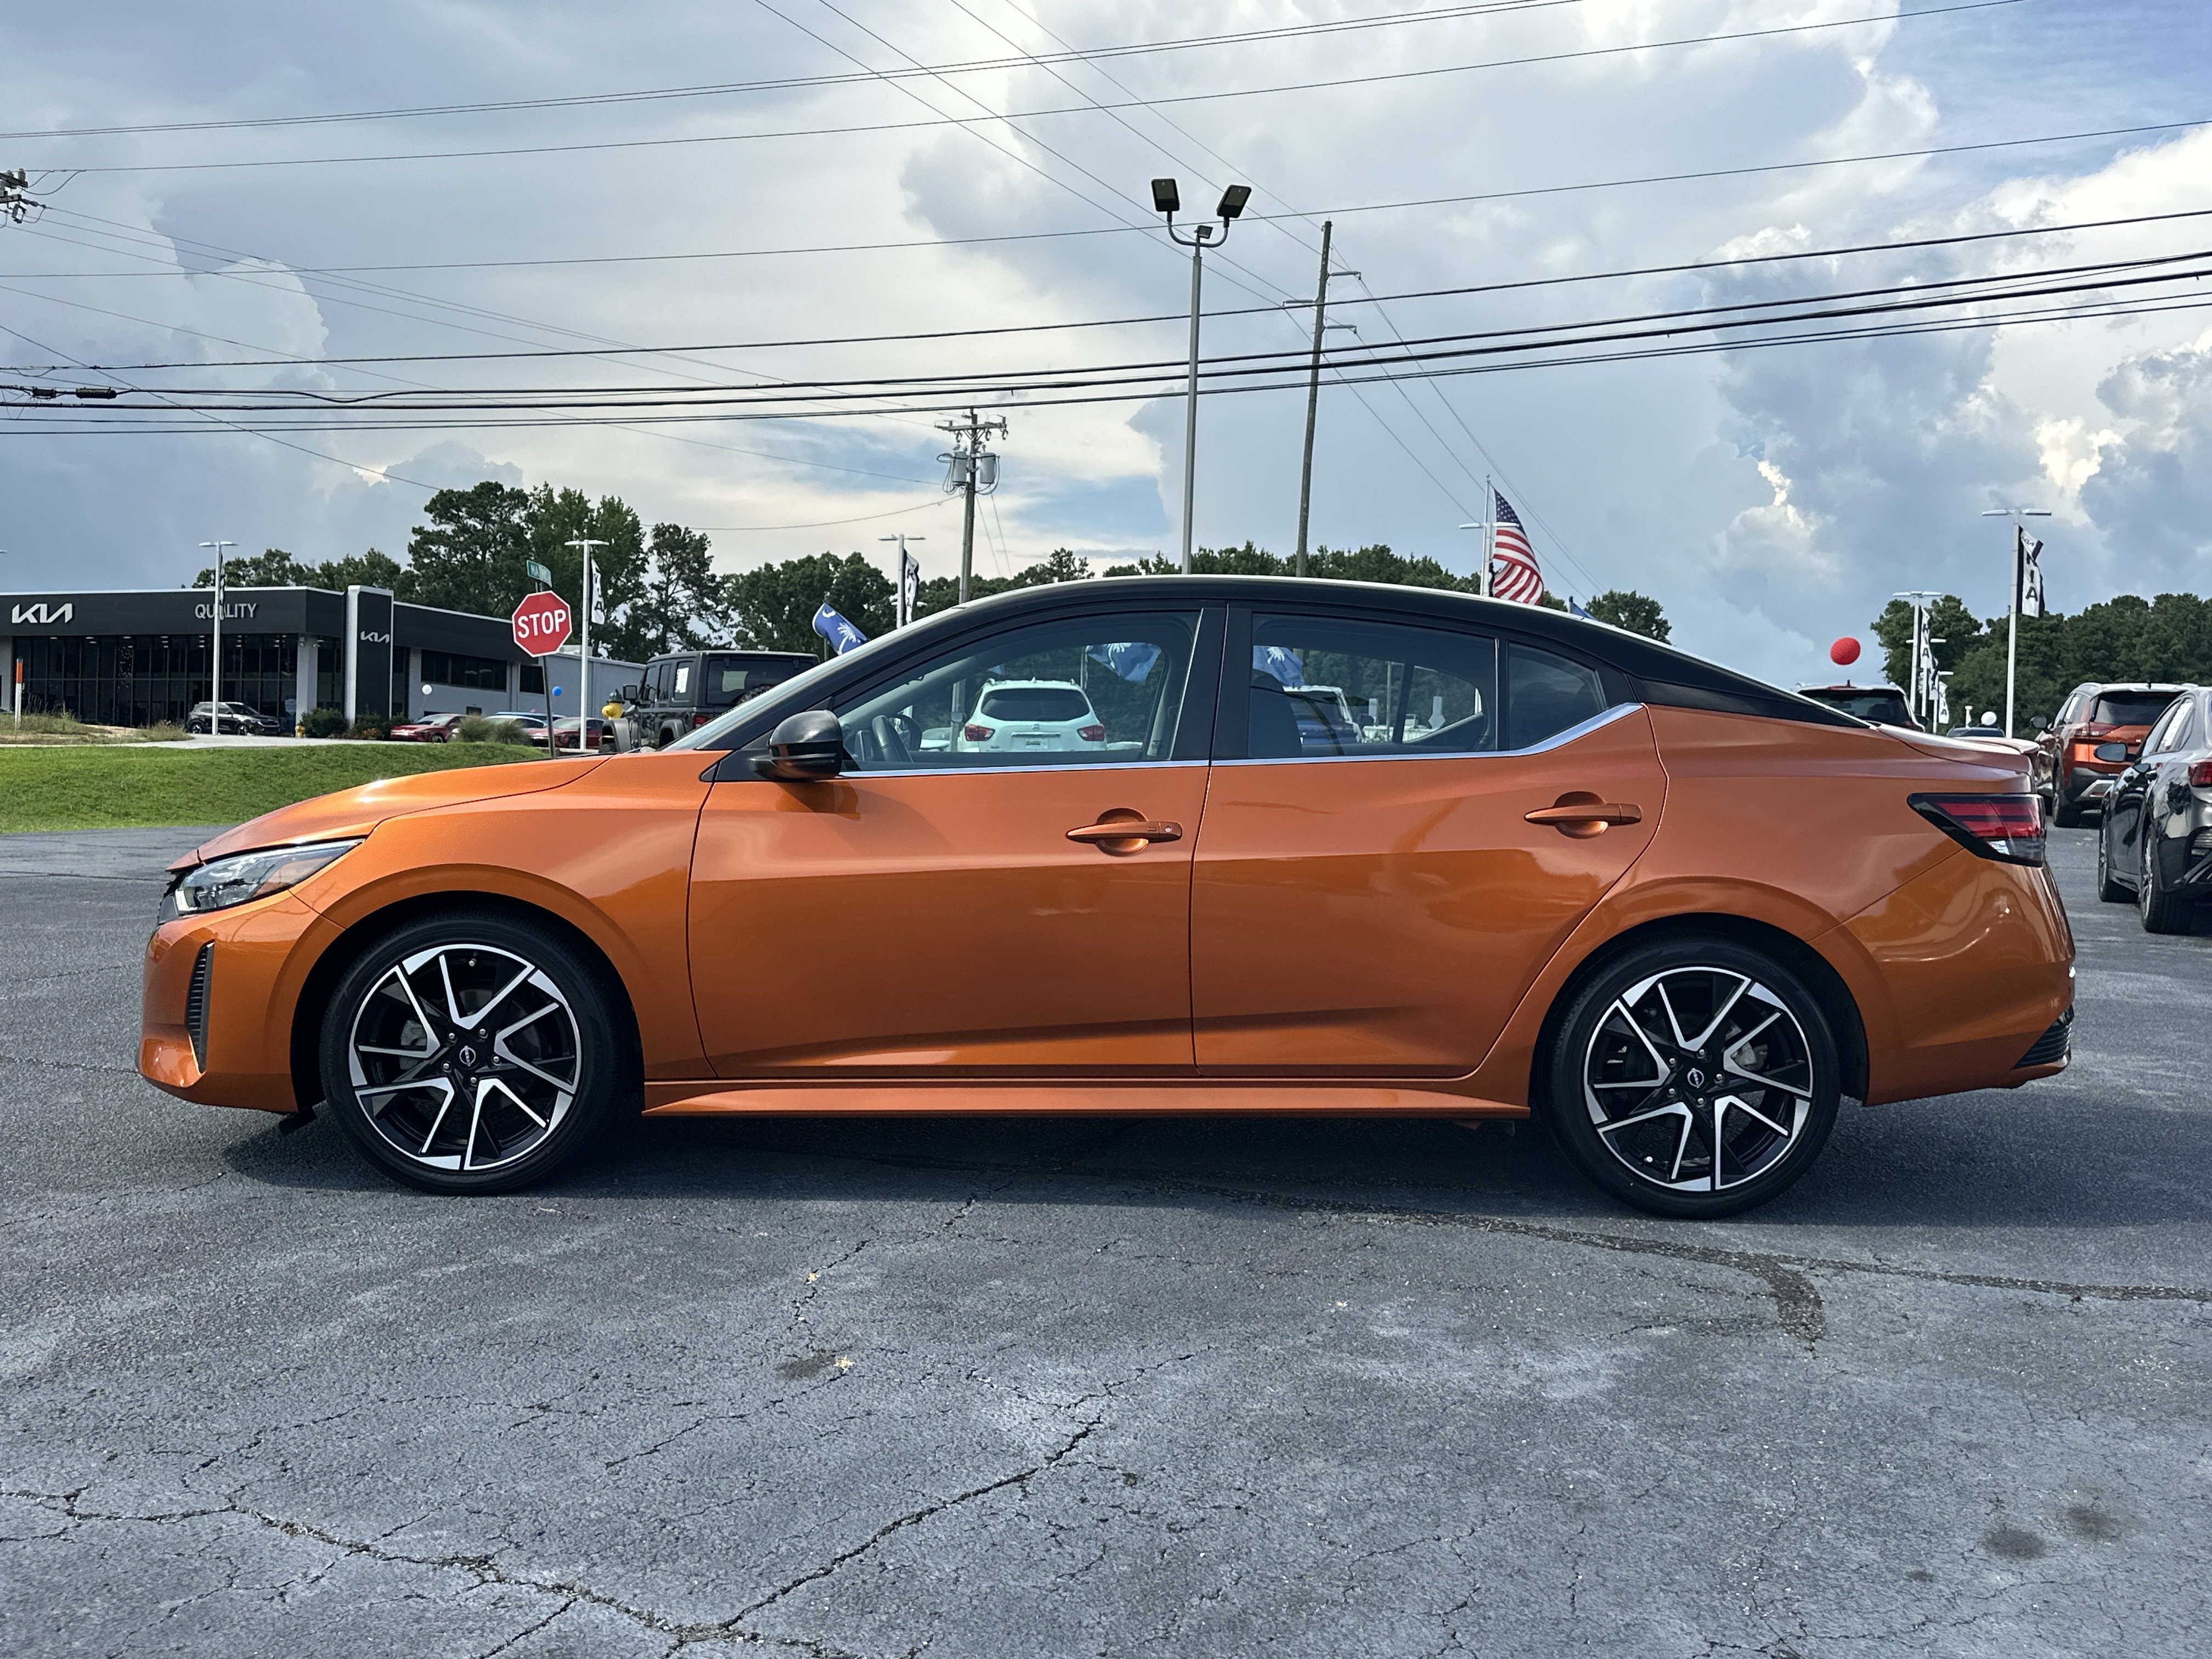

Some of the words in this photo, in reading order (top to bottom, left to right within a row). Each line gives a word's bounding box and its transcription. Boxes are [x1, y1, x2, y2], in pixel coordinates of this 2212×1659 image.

[12, 603, 72, 623] KIA
[518, 609, 566, 638] STOP
[360, 630, 390, 644] KIA
